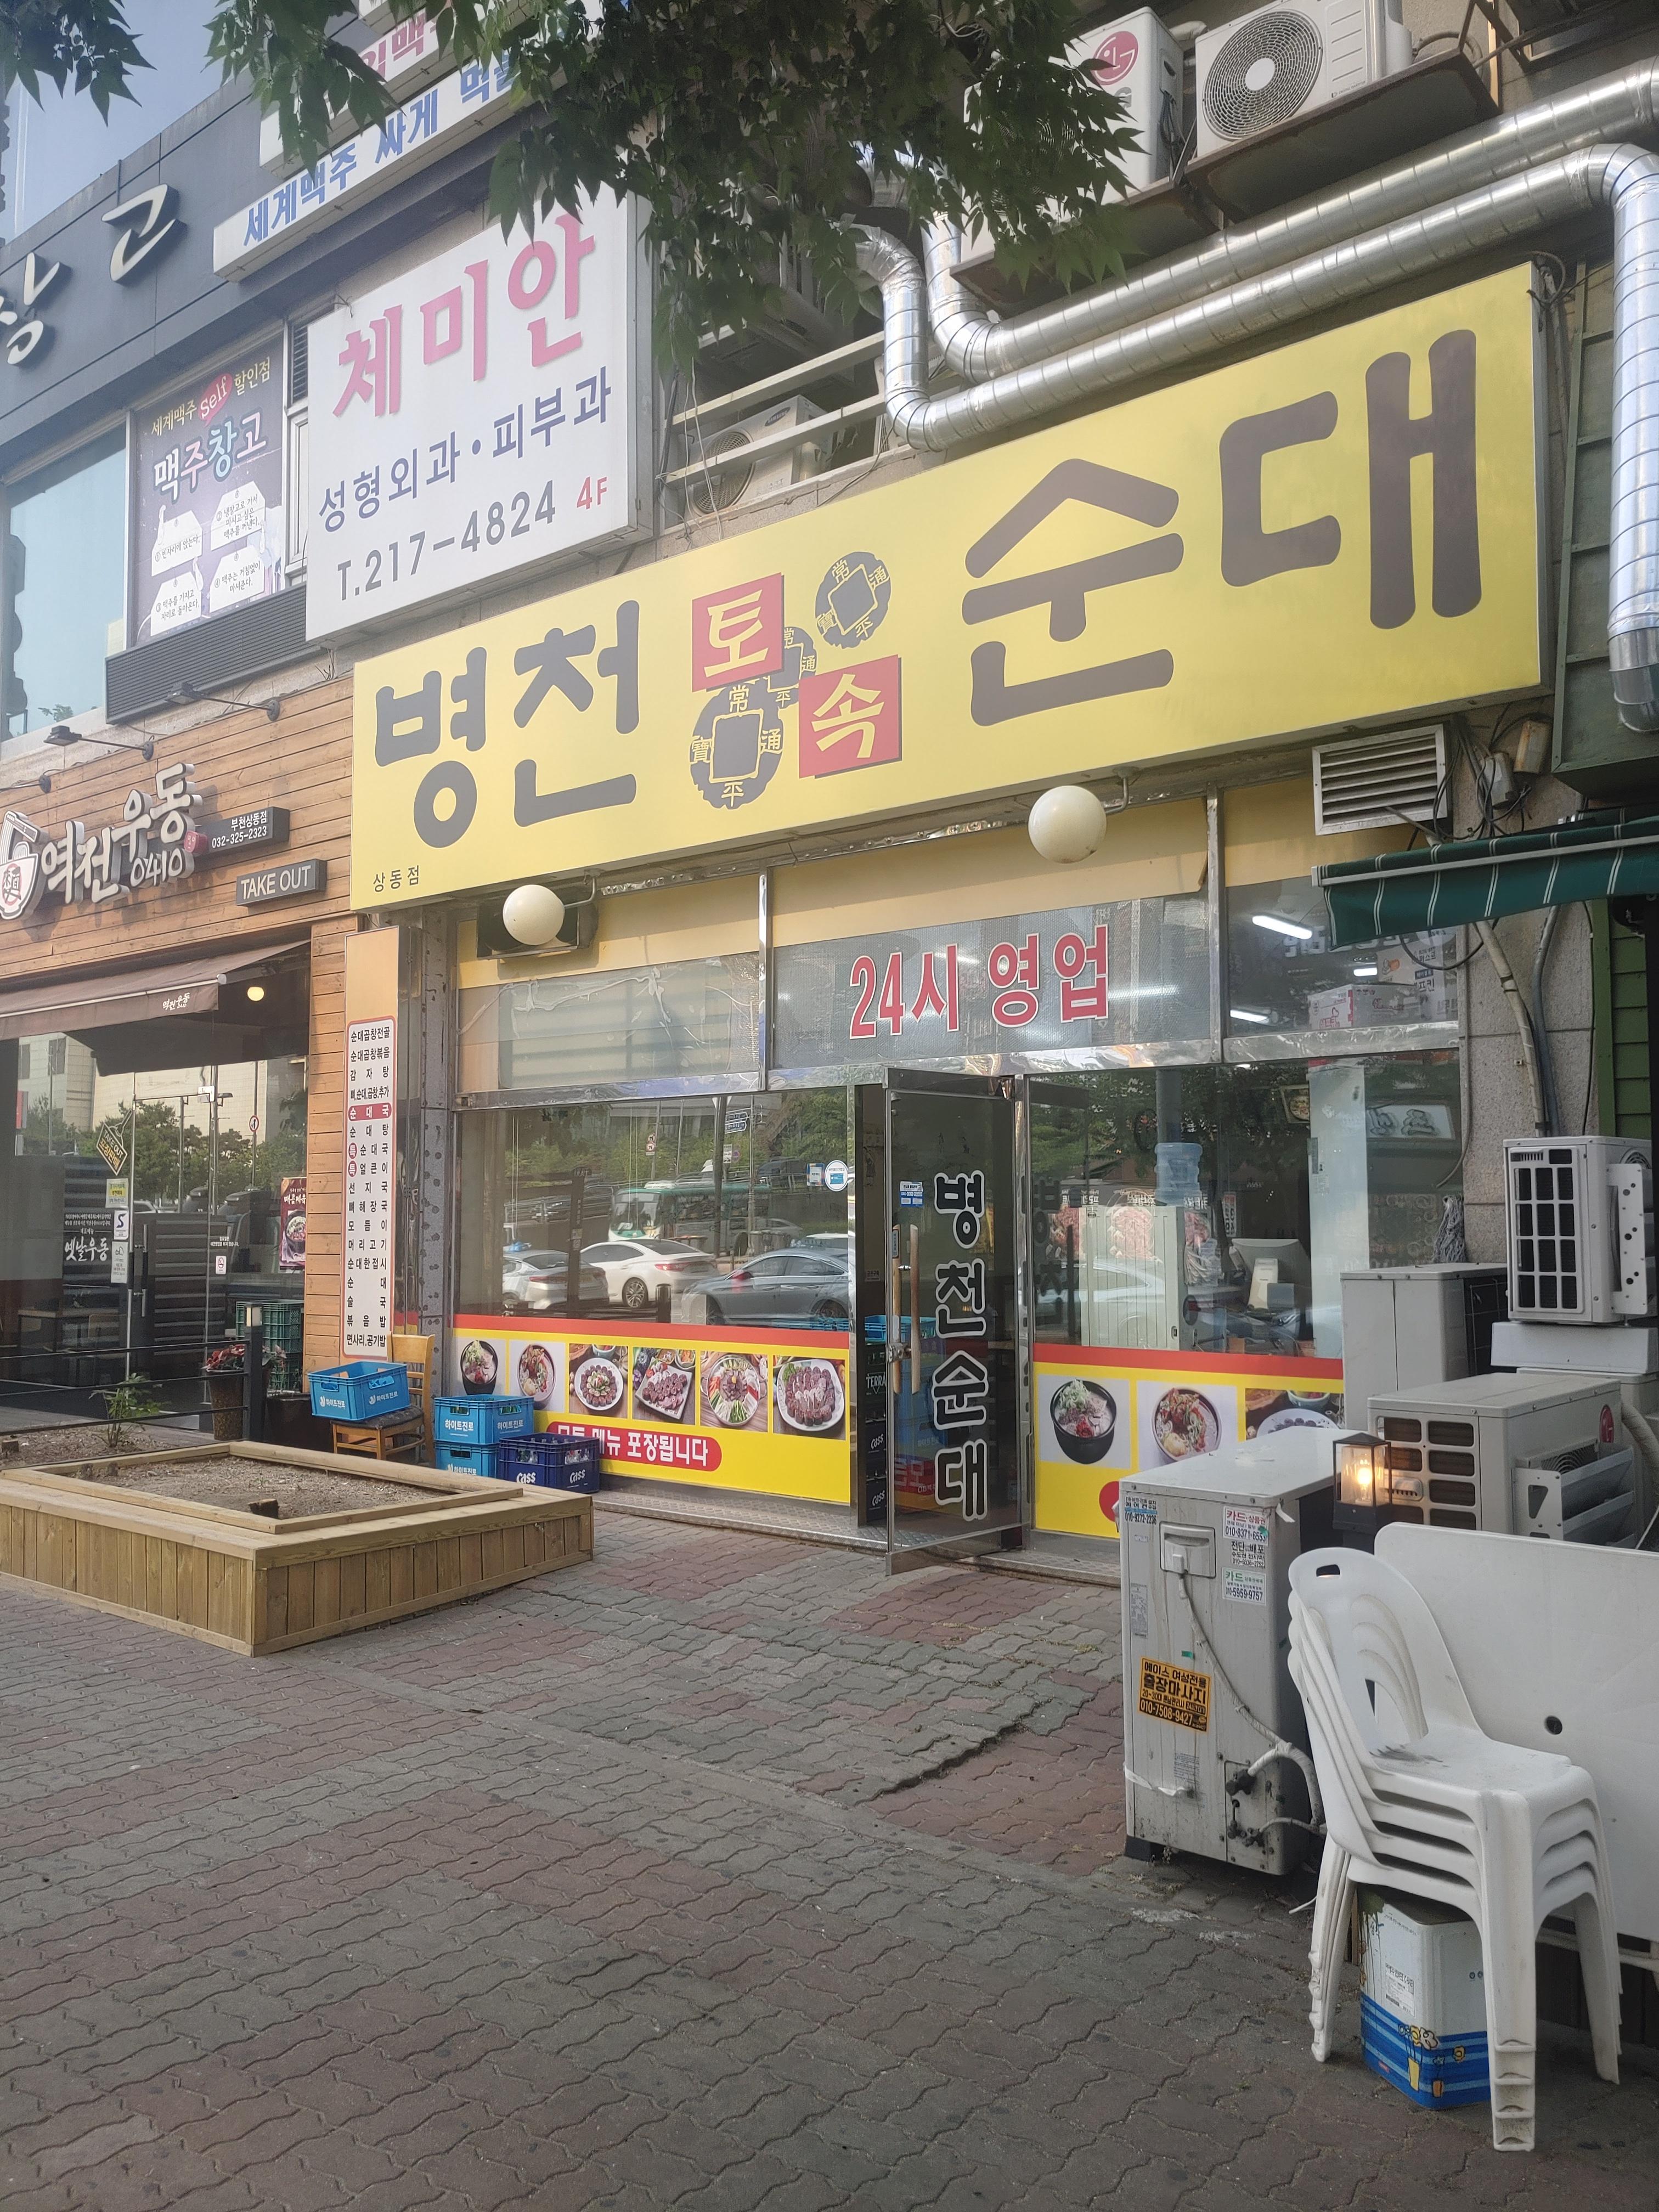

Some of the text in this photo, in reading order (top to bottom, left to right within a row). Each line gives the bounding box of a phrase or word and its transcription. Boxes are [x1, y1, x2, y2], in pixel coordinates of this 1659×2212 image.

[244, 143, 357, 247] 세계맥주
[332, 213, 595, 417] 체미안
[151, 400, 197, 437] 세계맥주
[234, 357, 271, 396] 할인점
[154, 411, 267, 499] 맥주창고
[247, 494, 258, 506] 가서
[337, 477, 607, 601] T.217-4824 4F
[222, 571, 238, 584] 맥주는
[240, 561, 261, 575] 거침없이
[179, 589, 194, 601] 가지고
[375, 600, 639, 848] 병천
[962, 329, 1482, 726] 순대
[161, 607, 176, 620] 자리로
[231, 810, 267, 830] 부천상동점
[41, 763, 195, 904] 역전우동
[212, 827, 267, 849] 032-325-2323
[131, 850, 183, 887] 0410
[241, 865, 312, 899] TAKE OUT
[373, 865, 420, 893] 상동점
[850, 924, 1109, 1039] 24시 영업
[351, 1026, 390, 1042] 순대곱창전골
[351, 1046, 390, 1062] 순대곱창볶음
[350, 1065, 389, 1081] 감자탕
[349, 1104, 389, 1120] 순대국
[349, 1124, 389, 1138] 순대탕
[103, 1128, 123, 1159] TAKE OUT
[349, 1143, 388, 1158] 특 순대국
[349, 1161, 388, 1176] 특 얼큰이
[349, 1181, 388, 1194] 선지국
[65, 1235, 109, 1262] 옛날우동
[348, 1238, 387, 1250] 머리고기
[347, 1257, 387, 1269] 순대한접시
[347, 1314, 386, 1328] 볶음밥
[933, 1170, 989, 1521] 병천순대
[866, 1373, 886, 1389] TERRA
[325, 1397, 346, 1409] 하이트진로
[376, 1391, 398, 1403] 하이트진로
[445, 1419, 474, 1432] 하이트진로
[497, 1419, 524, 1430] 하이트진로
[628, 1432, 708, 1466] 포장됩니다
[1225, 1571, 1244, 1582] 카드
[1144, 1661, 1170, 1678] 에이스
[1143, 1672, 1206, 1705] 출장마사지
[1141, 1699, 1193, 1726] 010-7508-9427
